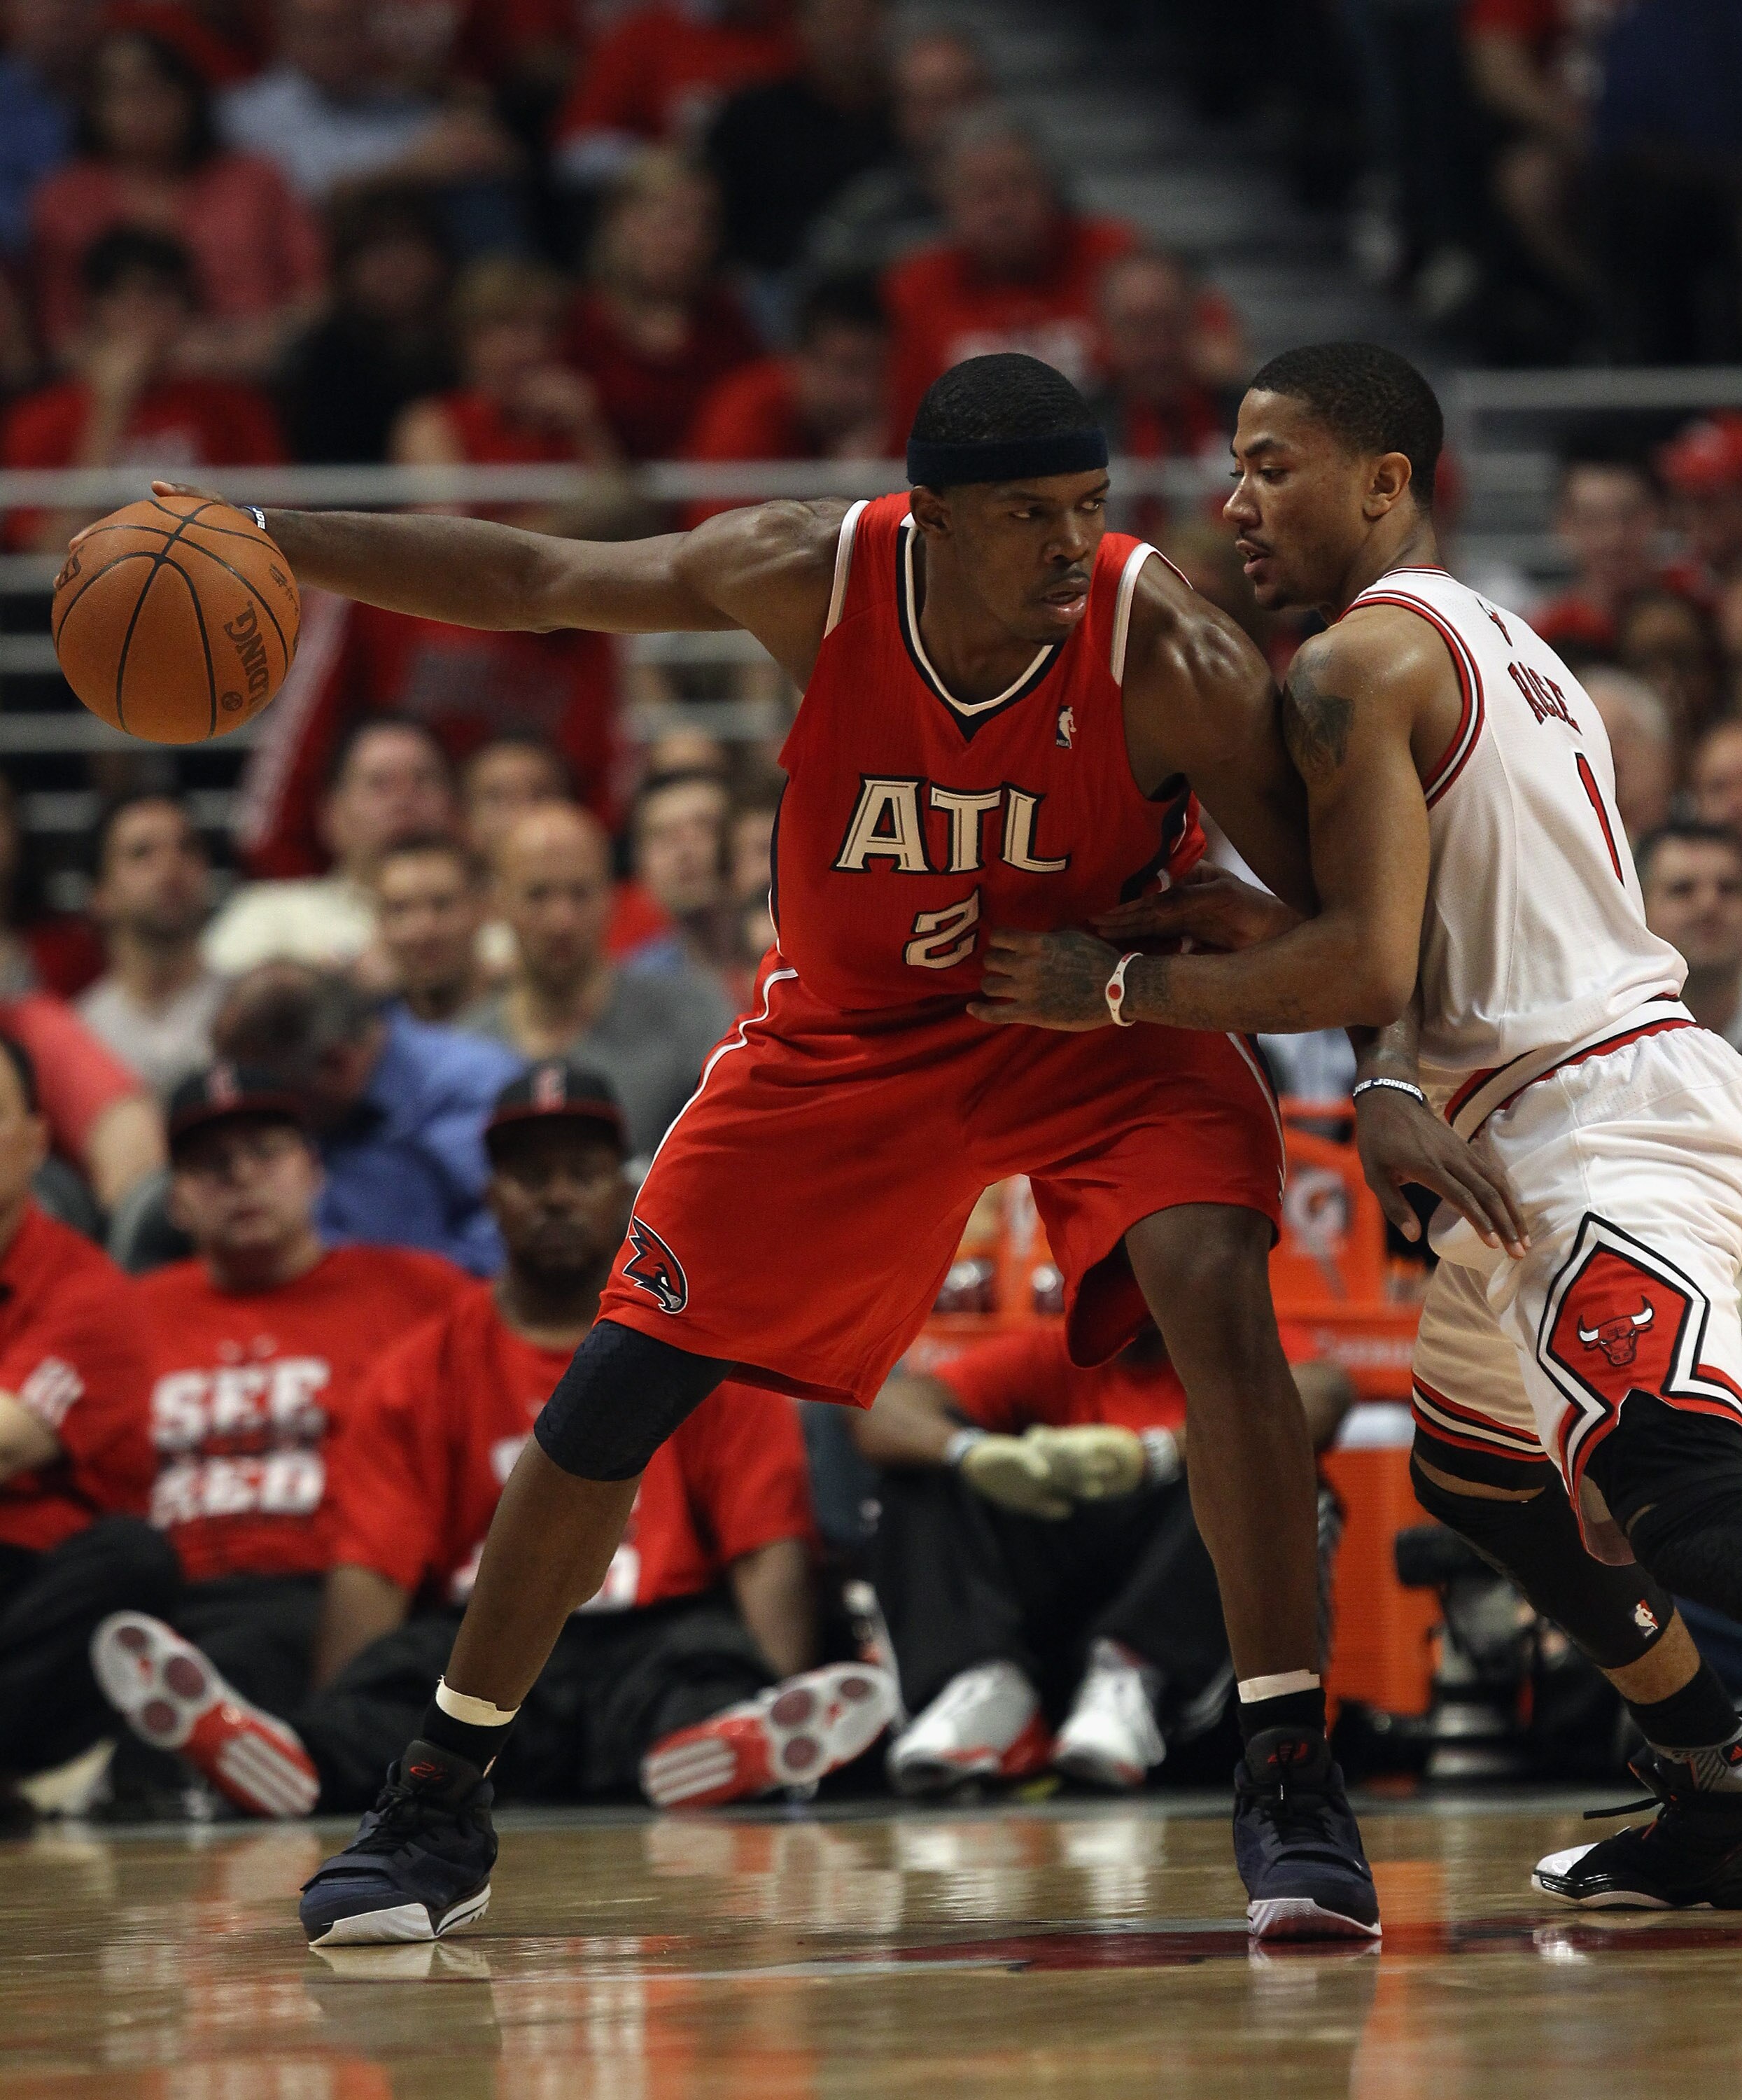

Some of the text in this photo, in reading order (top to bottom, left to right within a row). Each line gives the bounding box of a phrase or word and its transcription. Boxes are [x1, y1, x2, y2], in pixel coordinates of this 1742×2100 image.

[223, 600, 269, 710] LDING
[1507, 661, 1583, 736] ROSE
[829, 773, 1072, 875] ATL
[1574, 751, 1625, 888] 1
[902, 884, 981, 969] 2
[1352, 1079, 1372, 1097] JOE
[150, 1358, 329, 1448] SEE
